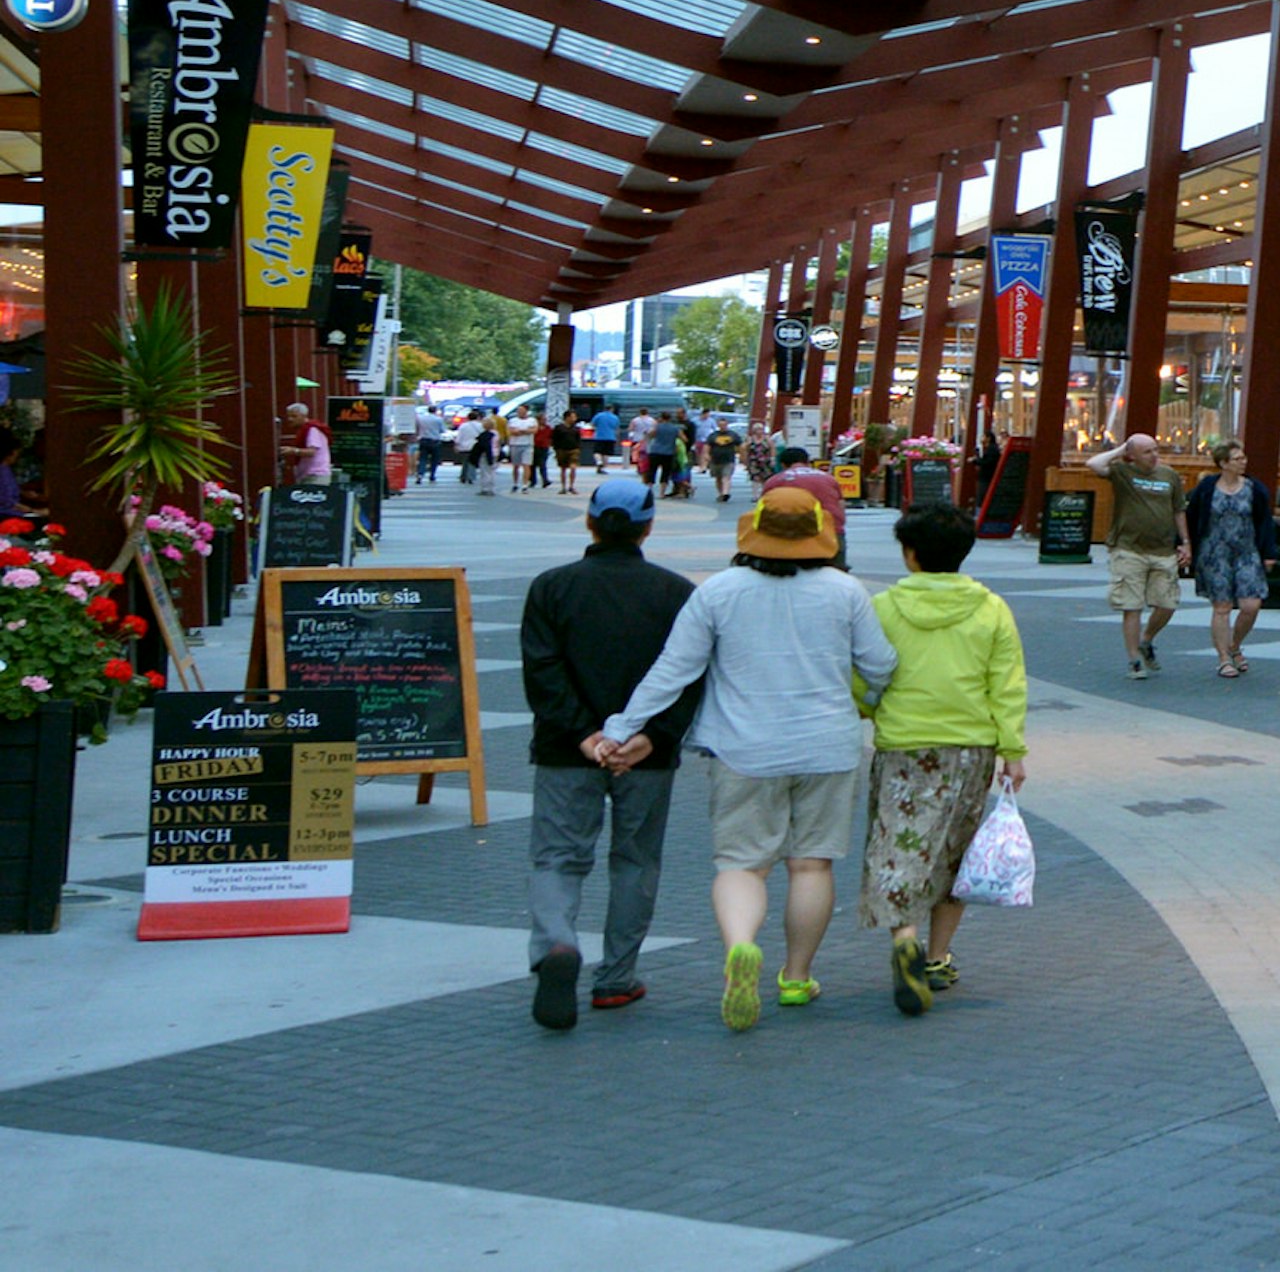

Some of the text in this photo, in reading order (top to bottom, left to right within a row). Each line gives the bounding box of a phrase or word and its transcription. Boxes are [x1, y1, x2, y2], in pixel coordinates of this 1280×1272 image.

[142, 67, 171, 216] Restaurant & Bar
[249, 145, 314, 287] Scotty's
[1000, 260, 1040, 272] PIZZA
[1088, 221, 1131, 313] Brew
[315, 586, 422, 607] Ambrosia
[192, 707, 320, 731] Ambrosia
[160, 747, 260, 760] HAPPY HOUR
[300, 750, 353, 765] 5-7pm
[160, 756, 258, 782] FRIDAY
[151, 787, 249, 803] 3 COURSE
[310, 788, 343, 802] $29
[152, 804, 269, 825] DINNER
[154, 828, 232, 845] LUNCH
[151, 843, 279, 864] SPECIAL
